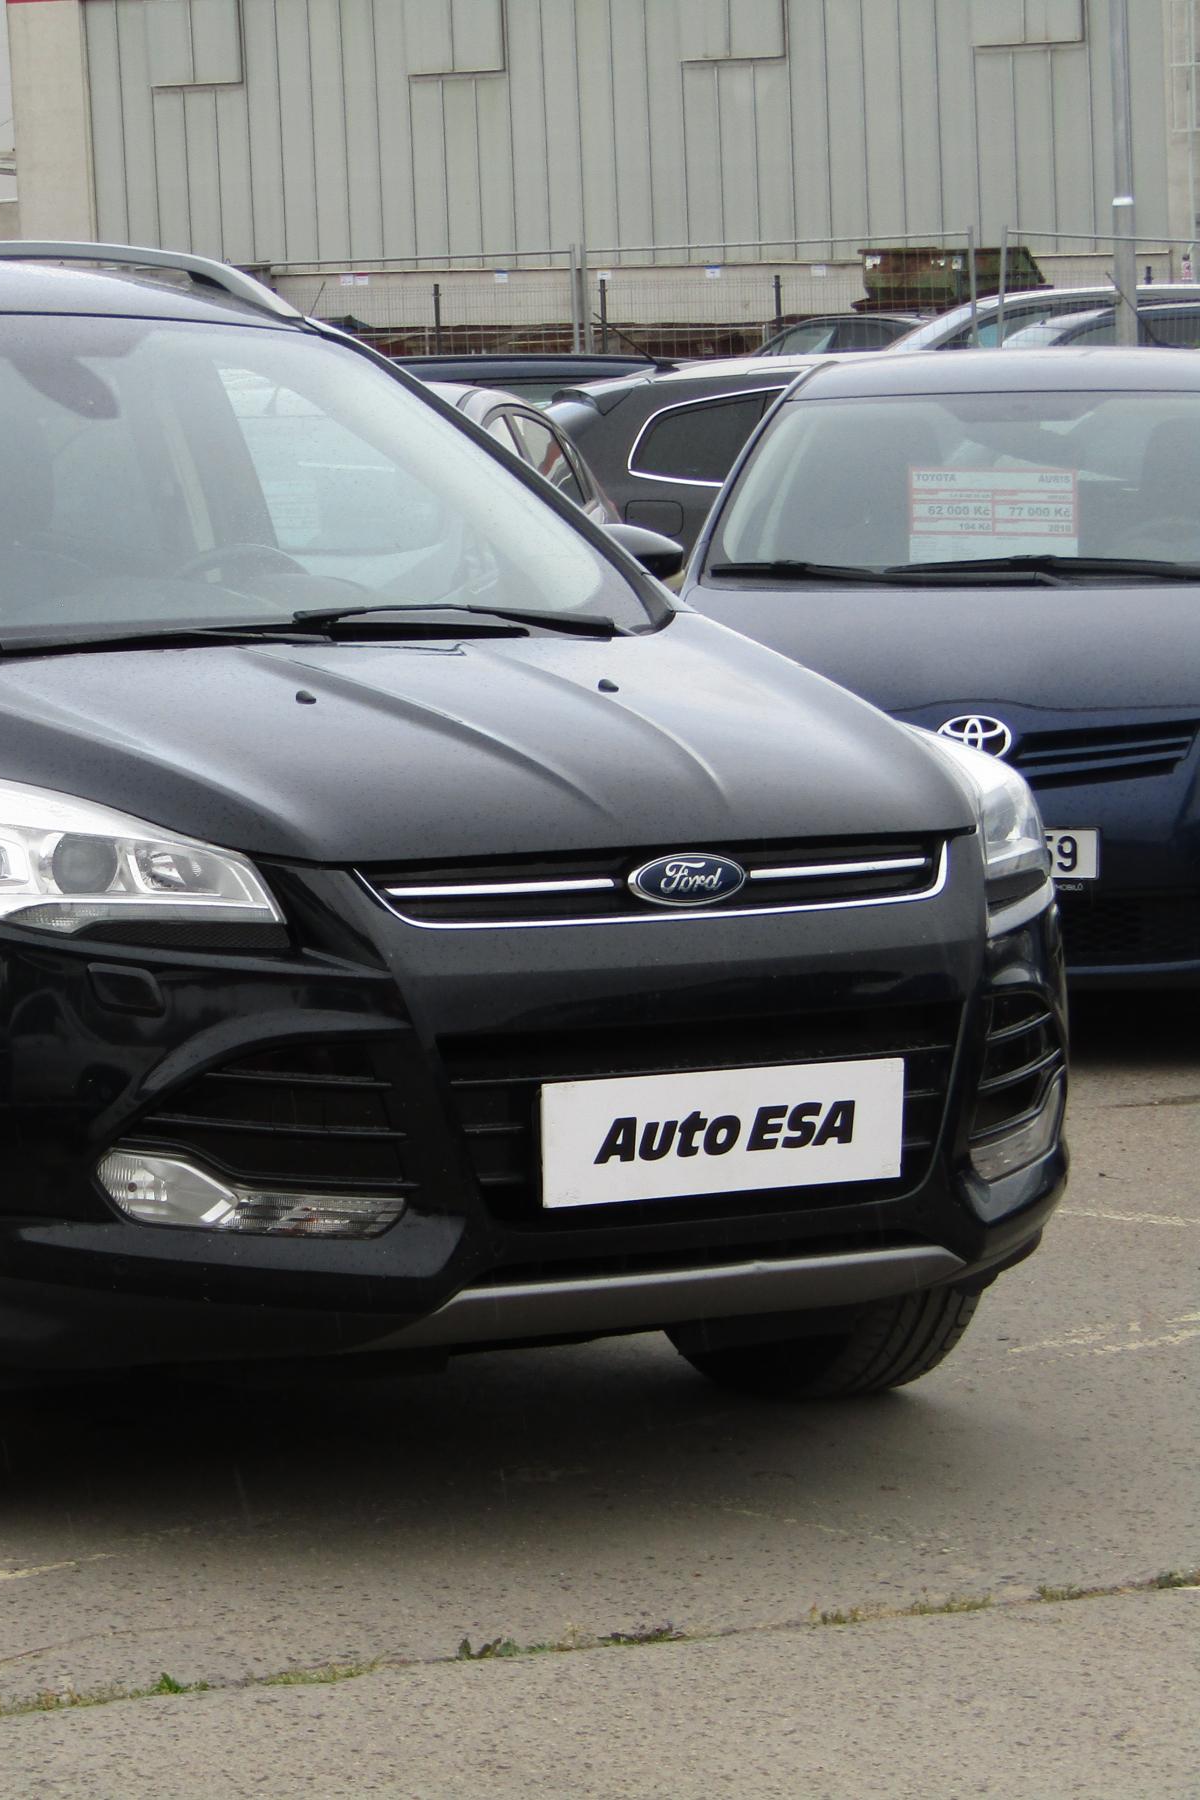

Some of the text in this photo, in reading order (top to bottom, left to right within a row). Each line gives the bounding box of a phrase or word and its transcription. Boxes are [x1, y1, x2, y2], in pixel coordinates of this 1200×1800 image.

[915, 473, 957, 482] TOYOTA
[660, 861, 723, 894] Ford
[593, 1100, 856, 1165] Auto ESA
